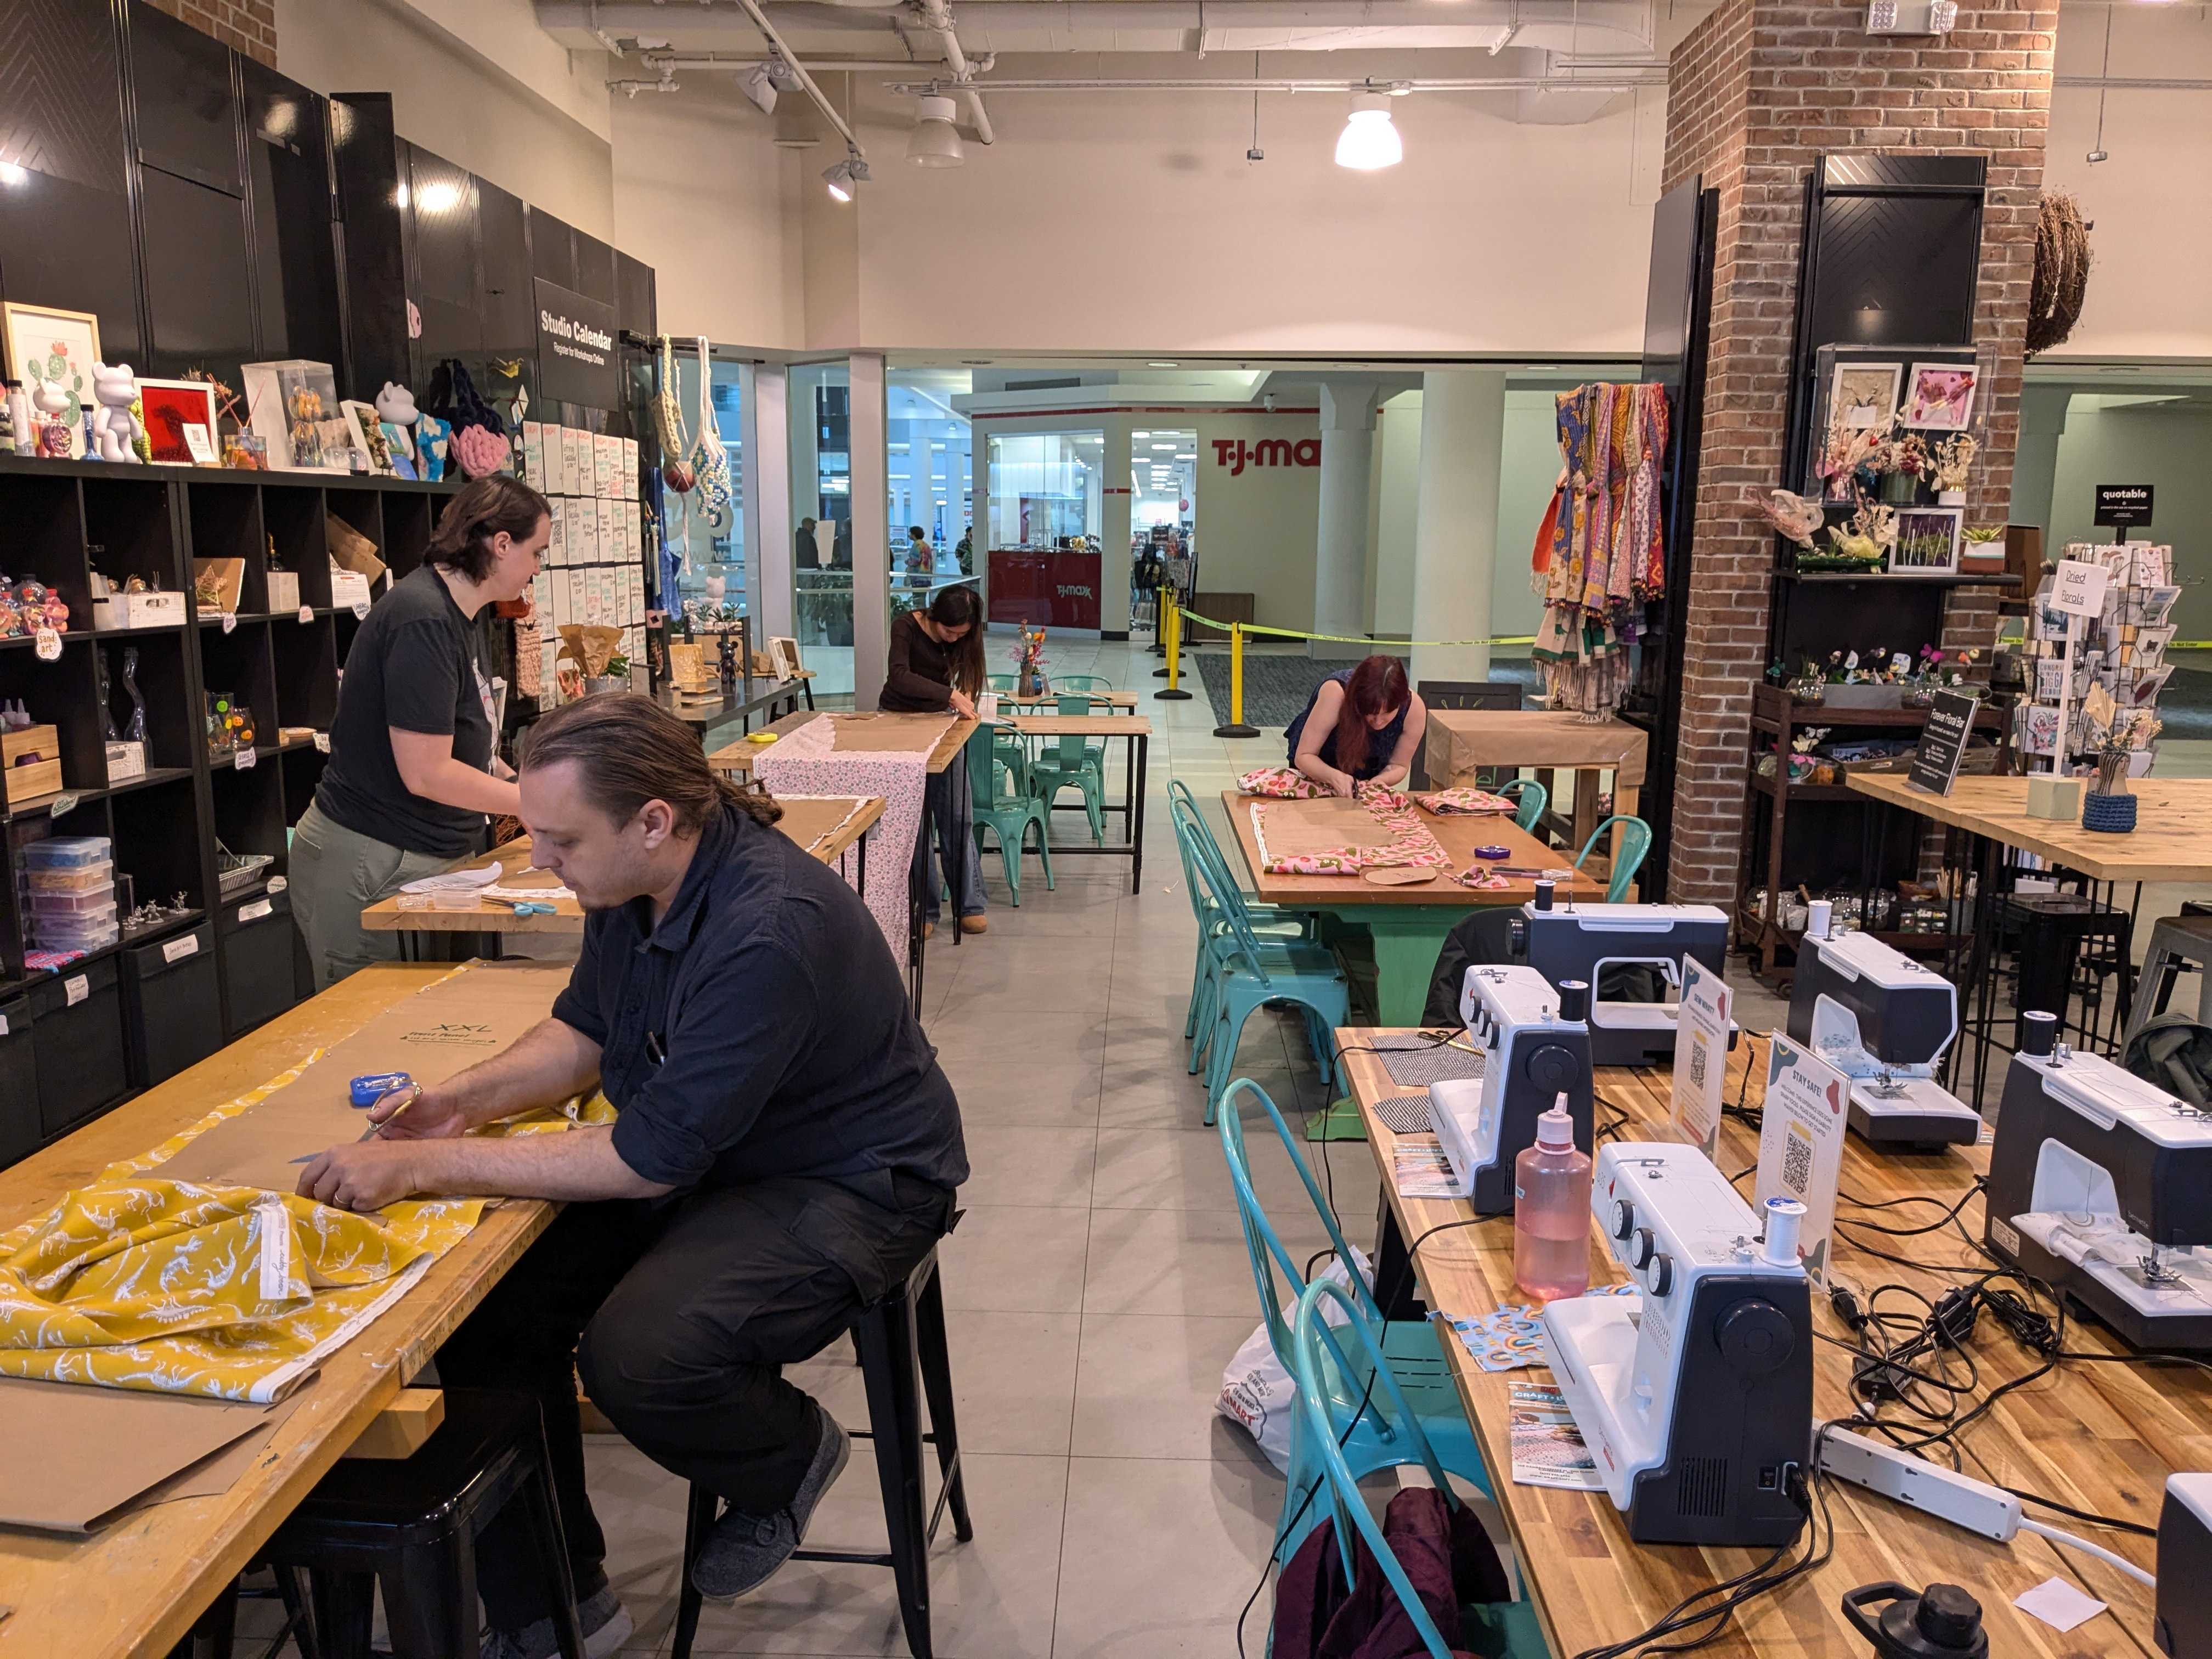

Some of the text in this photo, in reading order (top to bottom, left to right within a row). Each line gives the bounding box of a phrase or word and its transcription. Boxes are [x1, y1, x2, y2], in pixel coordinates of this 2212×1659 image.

[541, 310, 612, 351] Studio Calendar
[554, 341, 569, 356] Register
[574, 348, 593, 364] Workshops
[593, 353, 604, 366] Online
[2102, 489, 2147, 500] quotable
[2066, 569, 2086, 584] Dried
[2061, 590, 2085, 605] Florals
[39, 632, 54, 644] sand
[41, 644, 53, 652] art
[1931, 708, 1965, 729] Forever Floral Bar
[1792, 1070, 1821, 1098] STAY SAFE!
[1780, 1091, 1789, 1101] SHARP
[1799, 1105, 1809, 1116] PLEASE
[1818, 1119, 1831, 1132] LIABILITY
[1784, 1102, 1794, 1113] WAIVER
[1794, 1109, 1804, 1120] BELOW
[1802, 1098, 1817, 1113] EXPERIENCE
[1824, 1115, 1832, 1125] SOME
[1515, 1392, 1549, 1400] CRAFT
